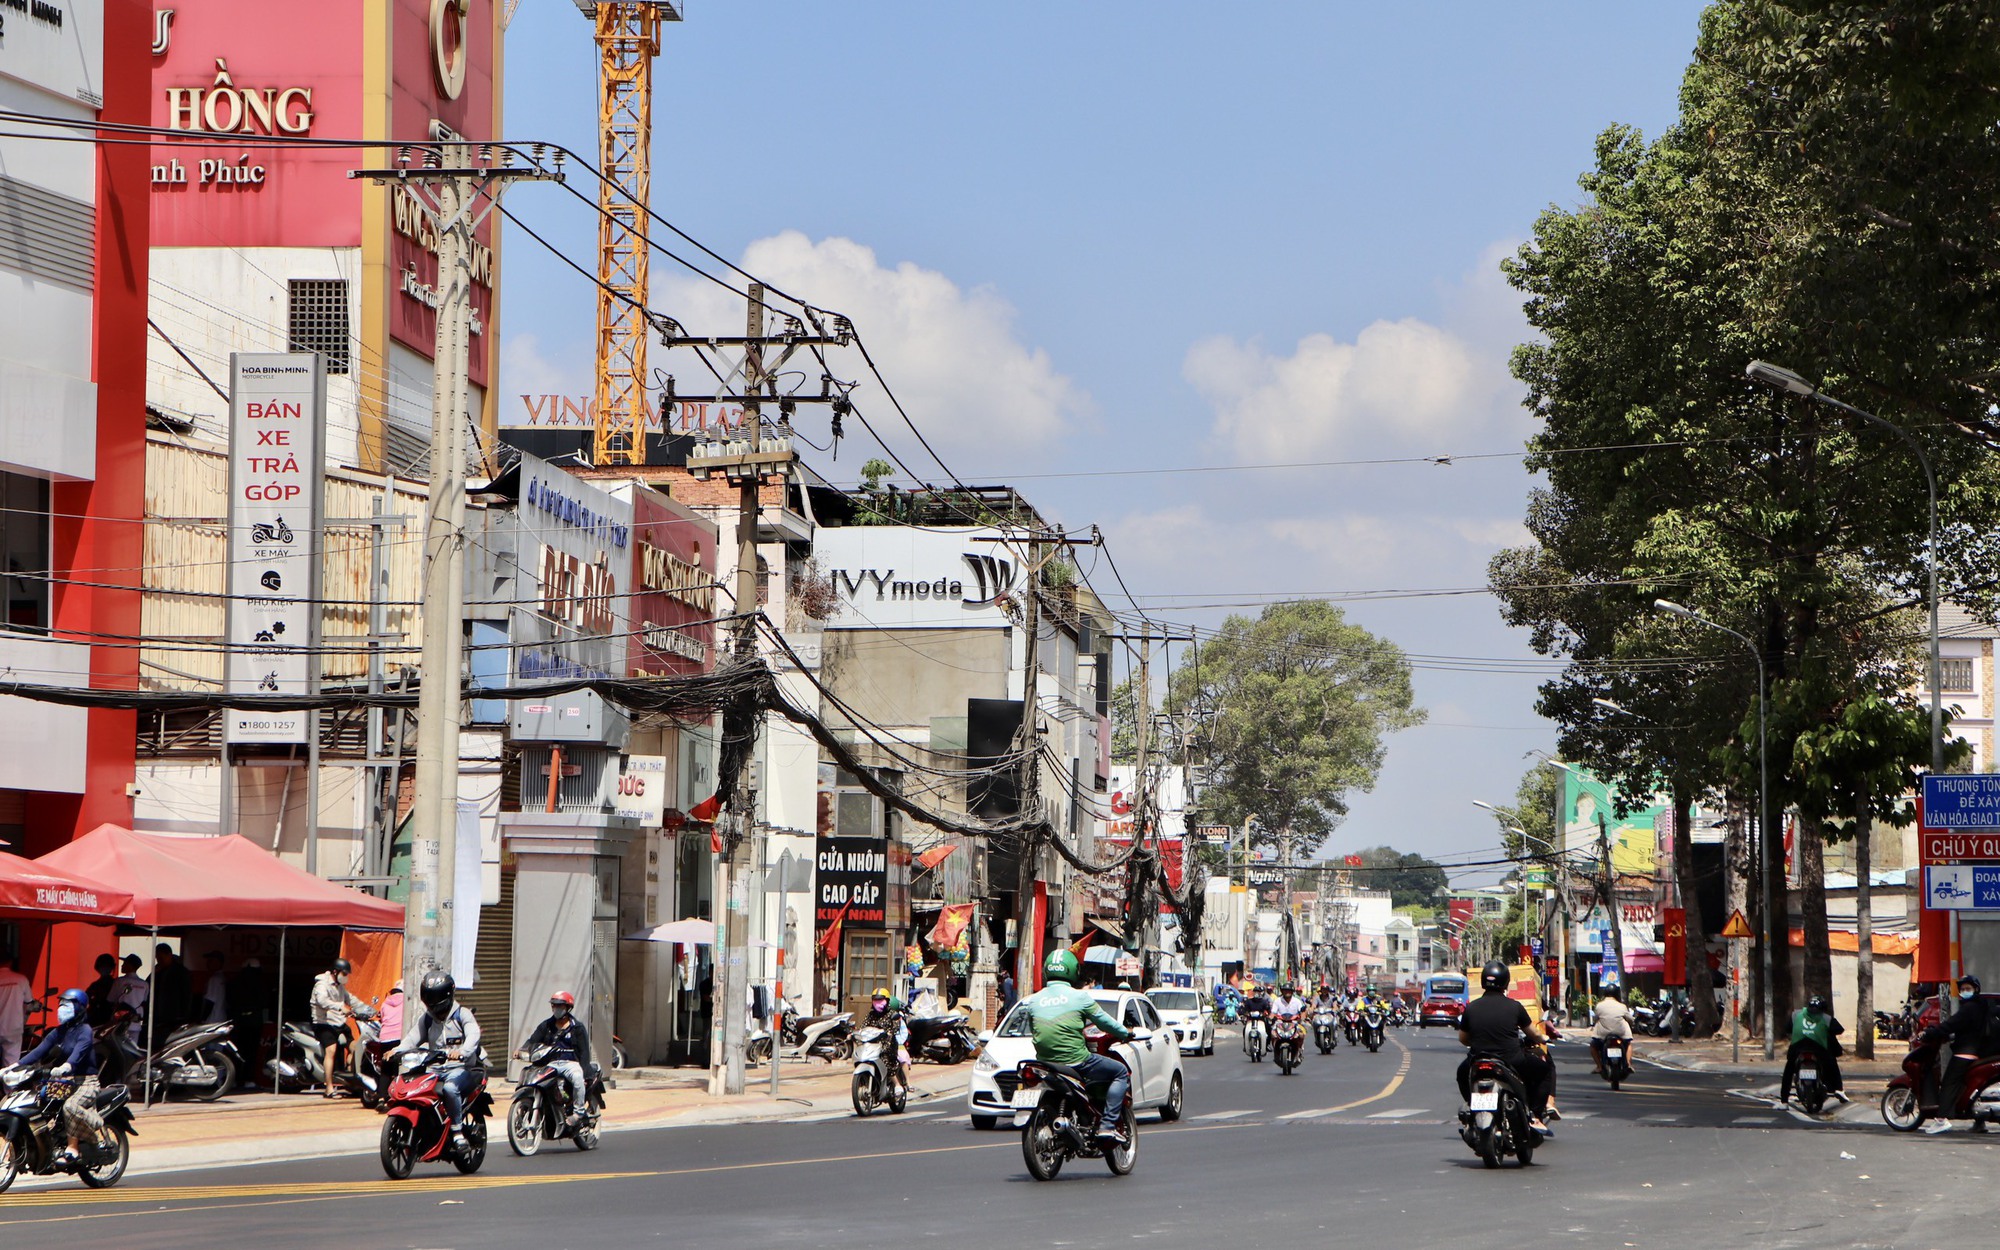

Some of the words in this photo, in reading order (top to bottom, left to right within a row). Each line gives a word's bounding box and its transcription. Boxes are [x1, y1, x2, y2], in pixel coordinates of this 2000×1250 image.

[166, 58, 314, 133] HỒNG
[199, 153, 266, 184] Phúc
[247, 398, 301, 418] BÁN
[257, 430, 290, 445] XE
[247, 452, 300, 473] TRẢ
[245, 481, 301, 501] GÓP
[268, 548, 289, 557] MÁY
[831, 569, 963, 596] IVYmoda
[248, 721, 270, 729] 1800
[274, 721, 296, 729] 1257
[1937, 779, 1979, 795] THƯỢNG
[1960, 793, 1975, 808] ĐỂ
[1927, 809, 1947, 825] VĂN
[1949, 809, 1969, 825] HÓA
[1971, 811, 1993, 825] GIAO
[1203, 827, 1227, 835] LONG
[1932, 836, 1965, 856] CHÚ
[1969, 835, 1979, 856] Ý
[819, 845, 844, 871] CỬA
[847, 849, 885, 872] NHÔM
[37, 888, 45, 903] XE
[45, 886, 59, 905] MÁY
[60, 888, 79, 906] CHÍNH
[79, 890, 98, 908] HÃNG
[823, 884, 848, 903] CAO
[853, 880, 880, 904] CẤP
[817, 909, 845, 920] KIM
[848, 909, 884, 920] NAM
[230, 934, 261, 954] HD
[1047, 964, 1065, 972] Grab
[1039, 995, 1069, 1007] Grab
